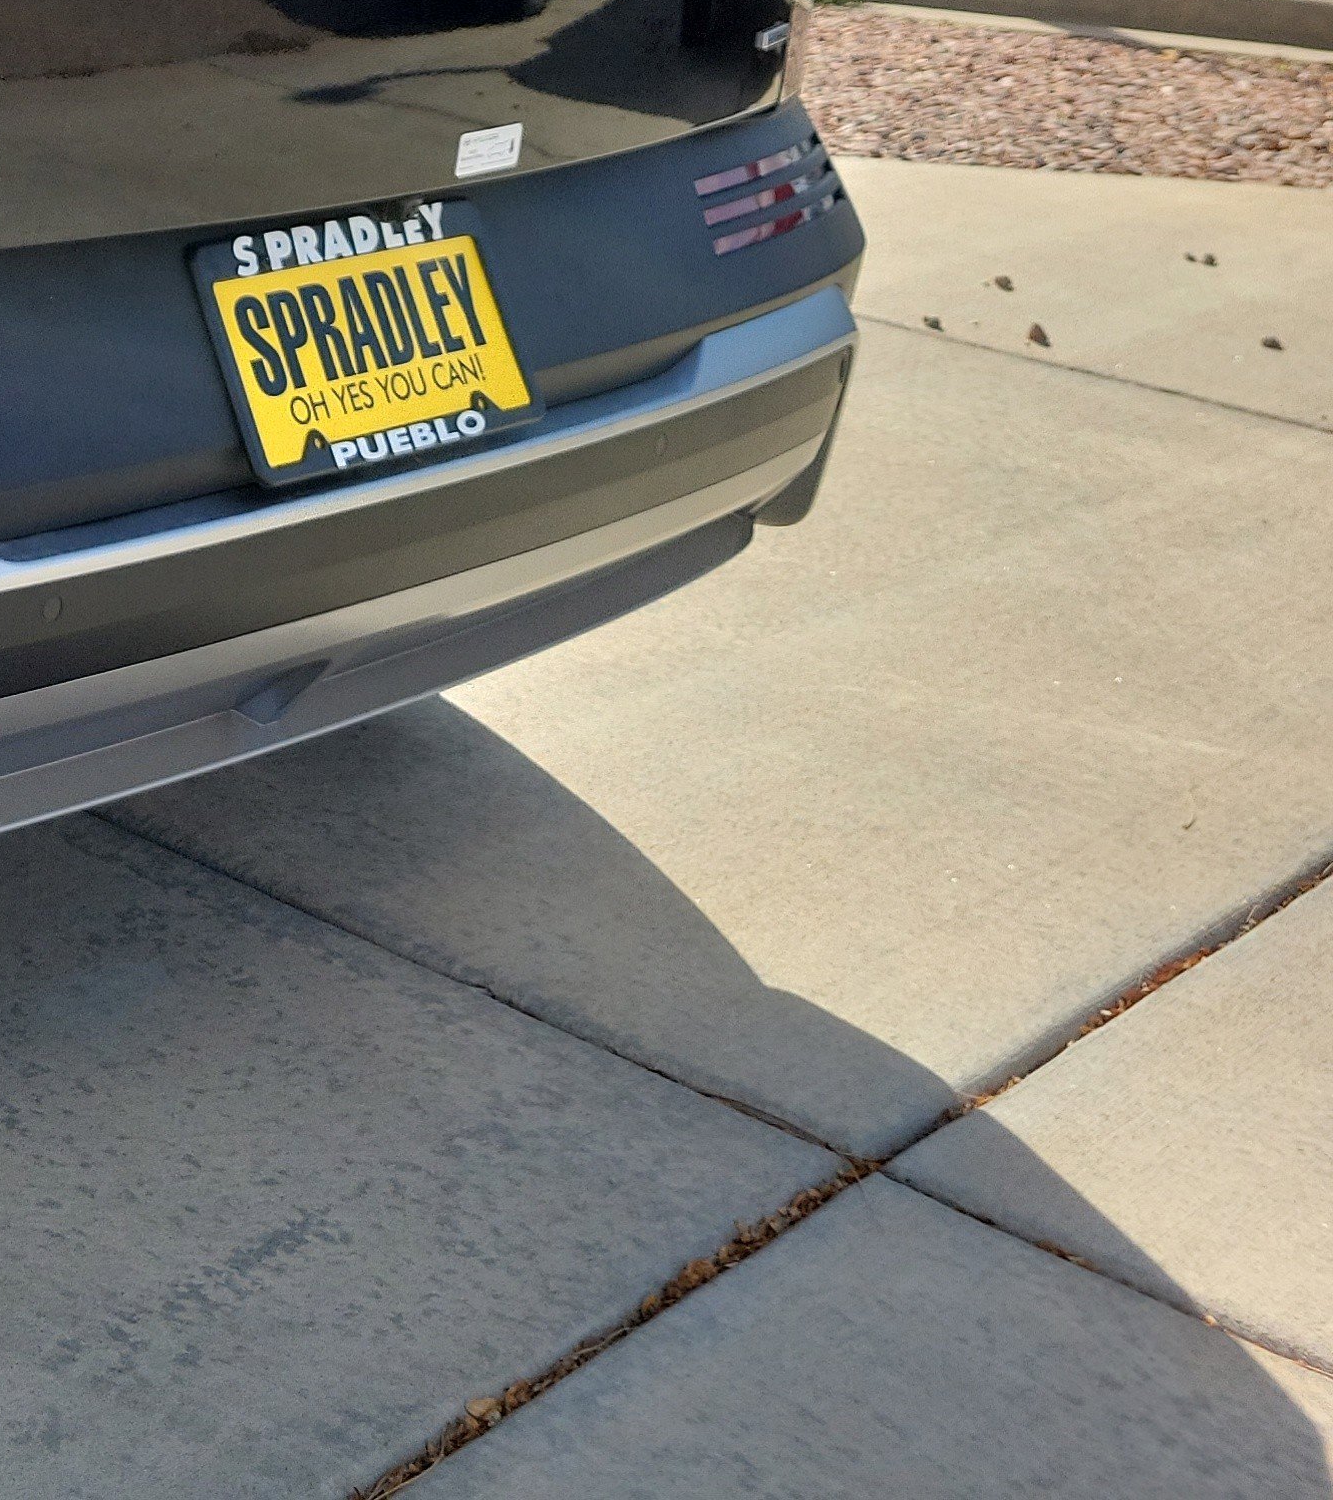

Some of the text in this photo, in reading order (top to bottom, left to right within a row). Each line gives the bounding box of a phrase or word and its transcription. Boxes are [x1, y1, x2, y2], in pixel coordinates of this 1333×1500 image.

[233, 202, 443, 277] SPRADLEY
[234, 253, 488, 397] SPRADLEY
[290, 353, 487, 425] OH YES YOU CAN!
[331, 410, 487, 470] PUEBLO
